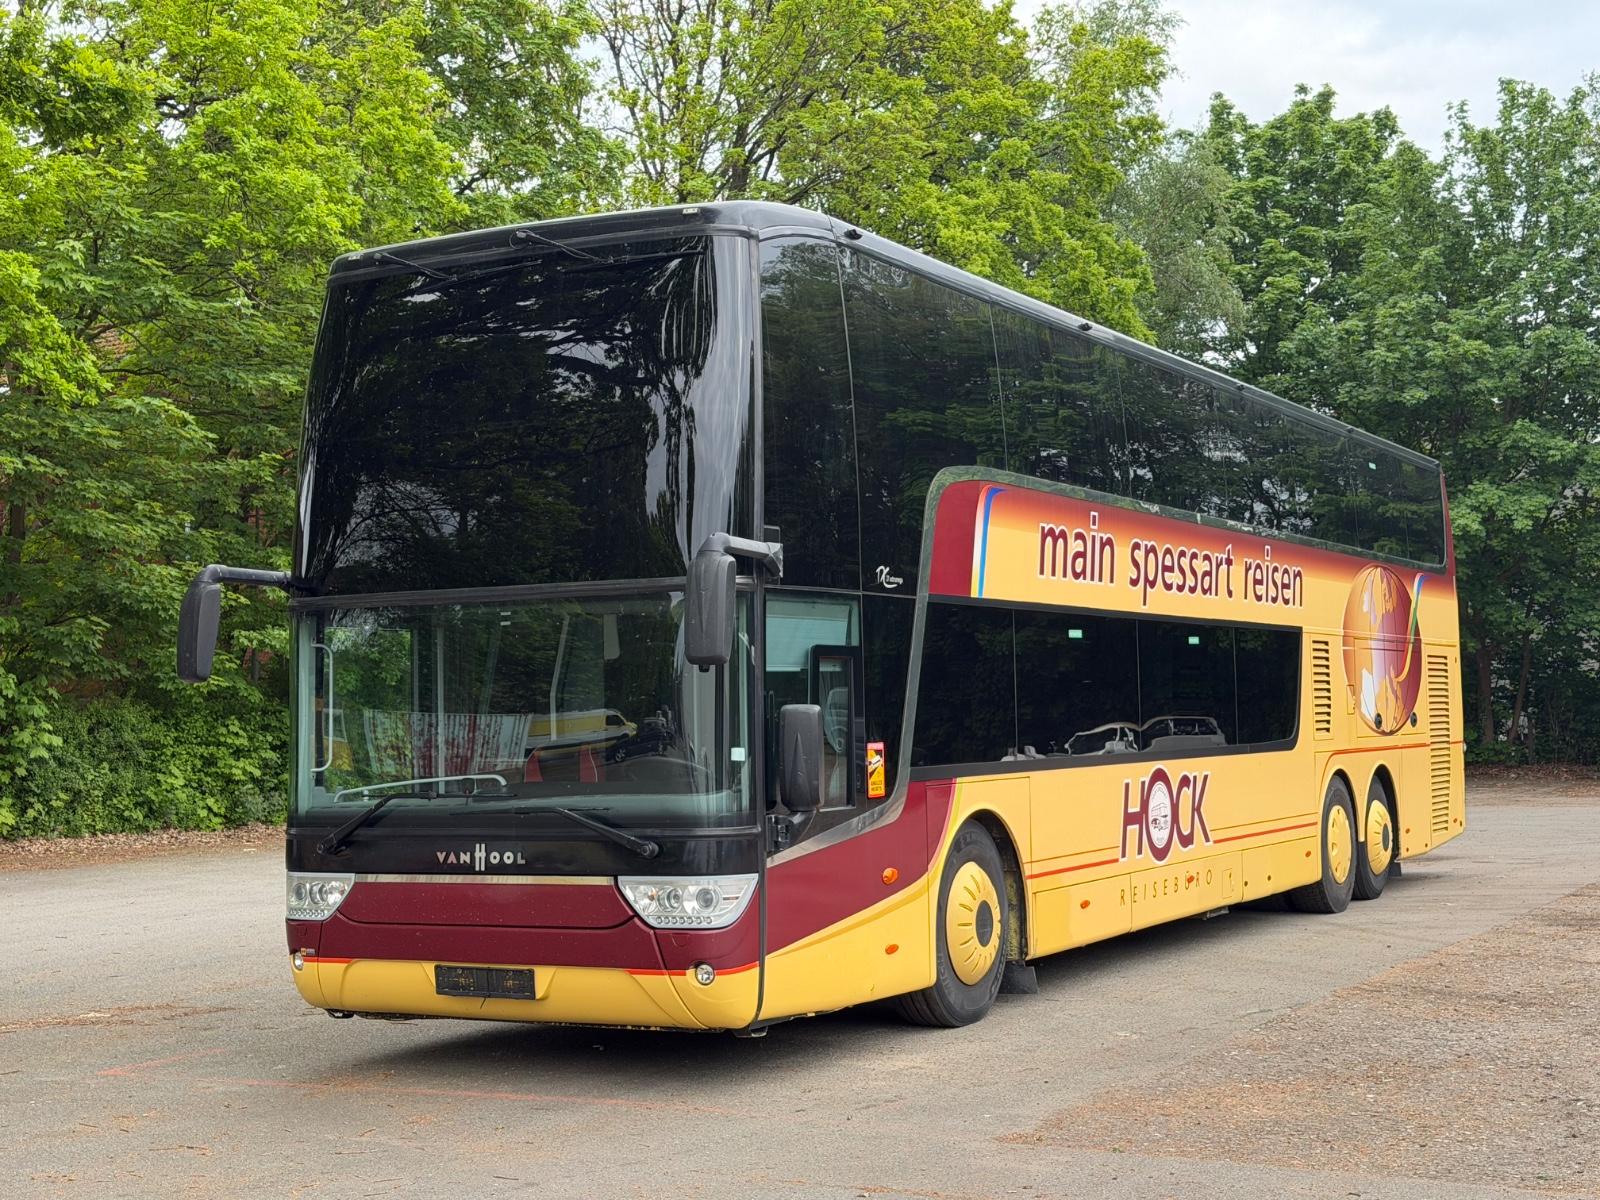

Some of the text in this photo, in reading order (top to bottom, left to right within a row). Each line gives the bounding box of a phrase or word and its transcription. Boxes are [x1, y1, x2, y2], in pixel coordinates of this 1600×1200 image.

[1039, 512, 1304, 608] main spessart reisen
[1121, 766, 1213, 863] HOCK
